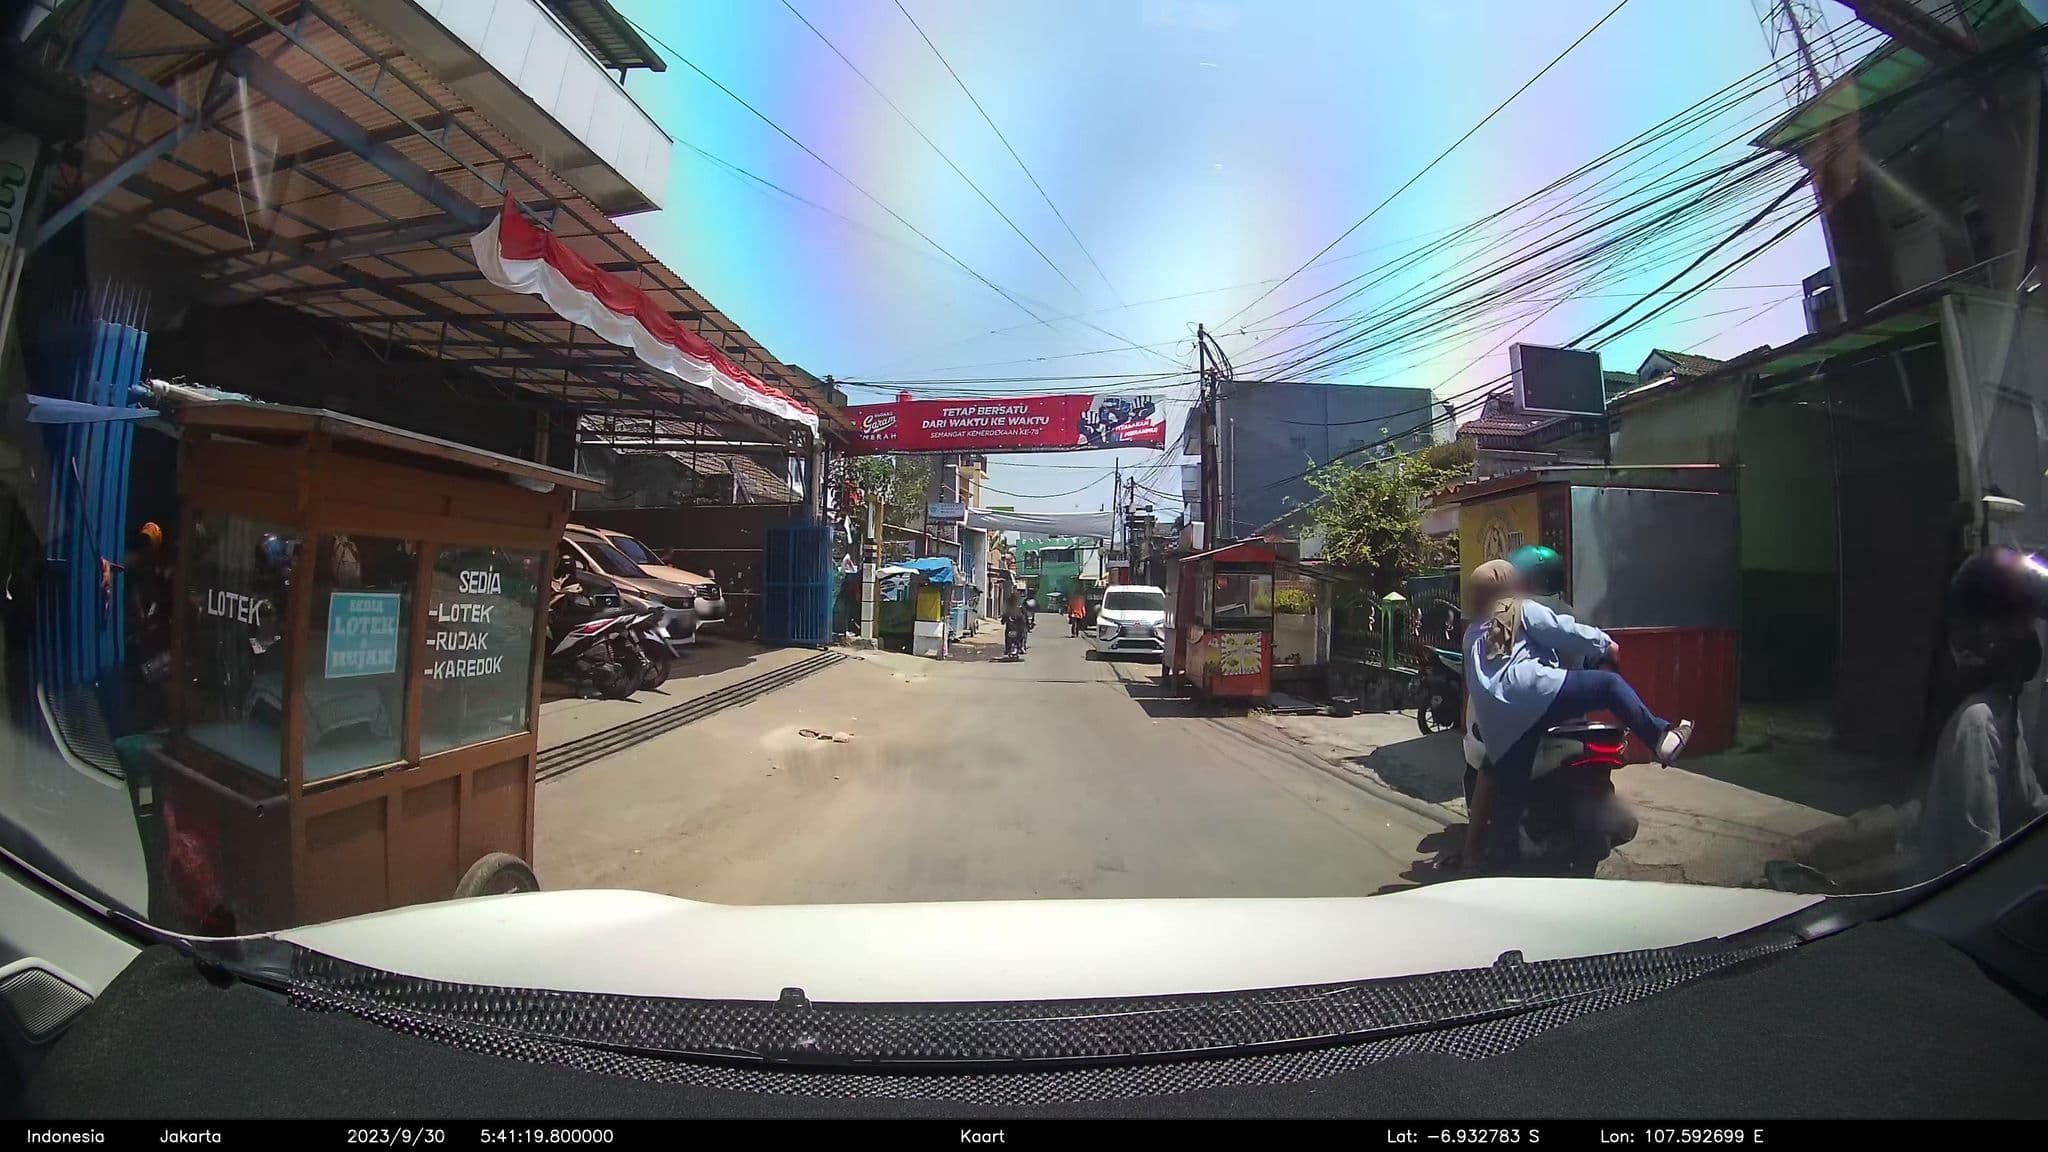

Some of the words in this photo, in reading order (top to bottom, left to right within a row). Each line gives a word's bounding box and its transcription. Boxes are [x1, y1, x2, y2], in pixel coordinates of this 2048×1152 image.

[943, 407, 976, 416] TETAP
[977, 405, 1028, 415] BERSATU
[922, 420, 947, 429] DARI
[949, 418, 988, 427] WAKTU
[991, 417, 1006, 426] KE
[1008, 416, 1050, 425] WAKTU
[930, 431, 966, 439] SEMANGAT
[967, 429, 1018, 438] KEMERDEKAAN
[459, 565, 501, 594] SEDIA
[208, 589, 264, 626] LOTEK
[335, 616, 394, 635] LOTEK
